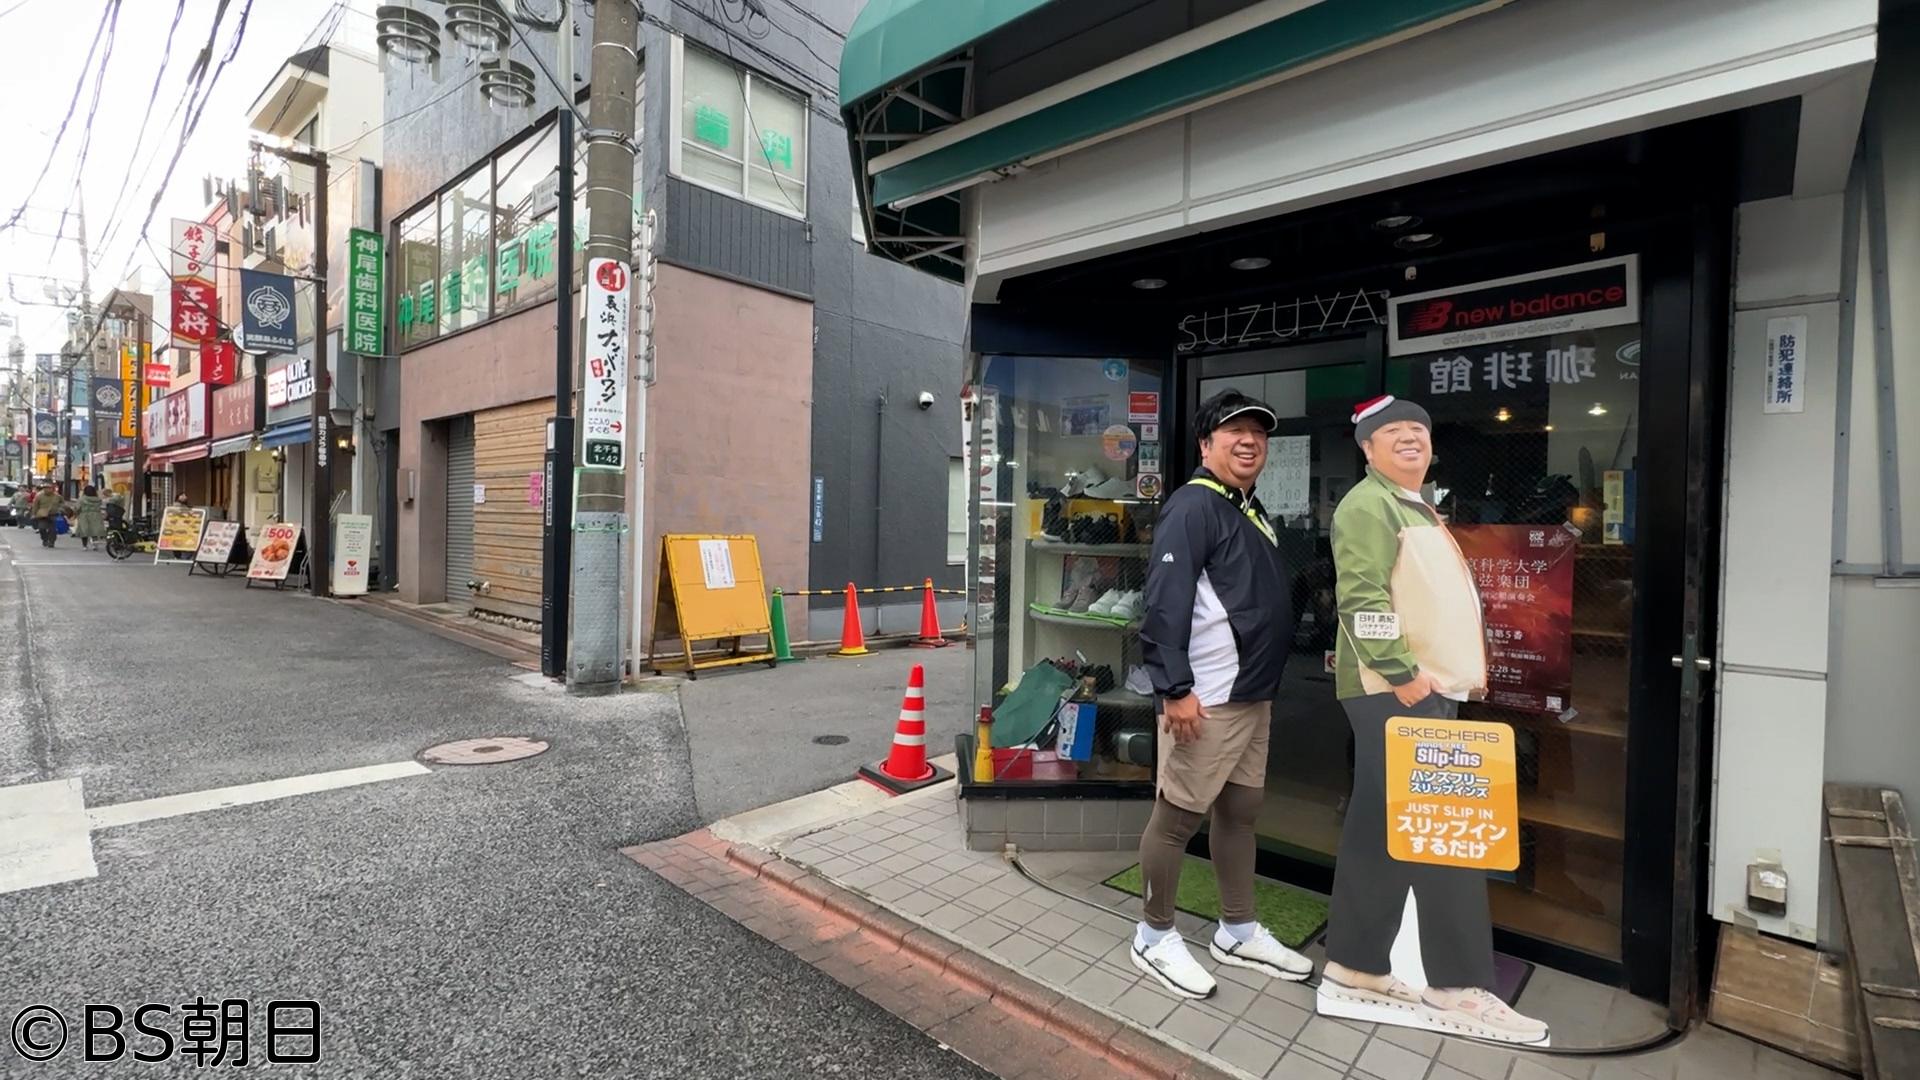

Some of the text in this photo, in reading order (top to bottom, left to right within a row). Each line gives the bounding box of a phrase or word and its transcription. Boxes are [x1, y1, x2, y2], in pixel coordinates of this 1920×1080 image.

[354, 235, 379, 353] 神尾歯科医院
[1455, 305, 1505, 326] new
[1509, 286, 1623, 318] balance
[178, 284, 211, 336] 王将
[1178, 288, 1379, 352] SUZUYA
[213, 345, 223, 381] ラーメン
[1776, 334, 1796, 404] 防犯連絡所
[267, 528, 294, 540] 500
[1473, 573, 1530, 589] 弦楽団
[1397, 726, 1500, 743] SKECHERS
[1415, 747, 1482, 768] Slip-ins
[1410, 768, 1491, 786] ハンズフリー
[1409, 781, 1490, 798] スリップインズ
[1404, 802, 1494, 820] JUST SLIP IN
[1396, 815, 1508, 841] スリップイン
[1409, 835, 1489, 859] するだけ
